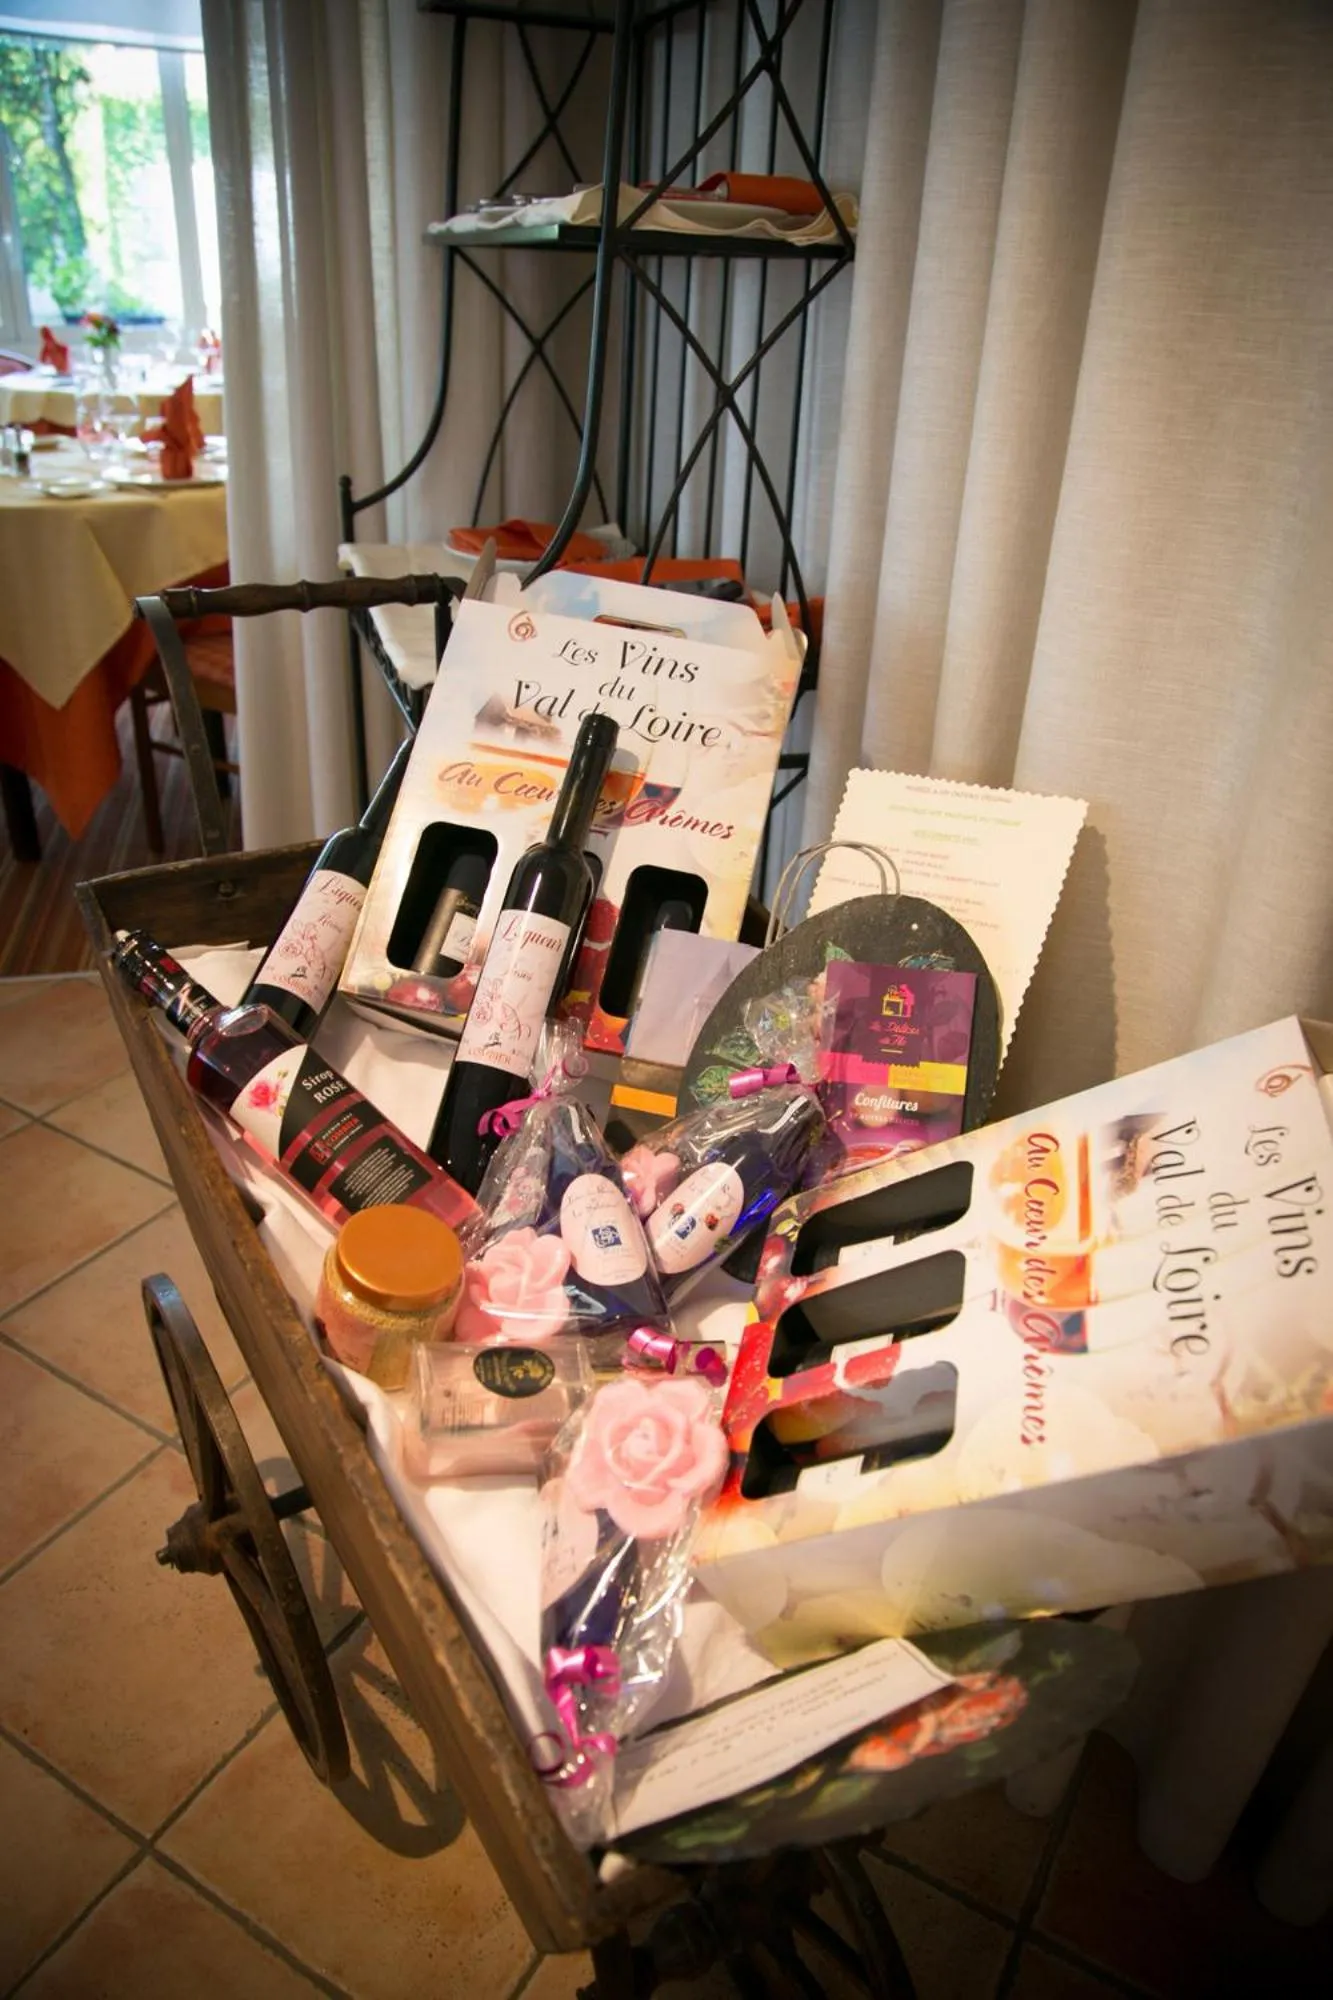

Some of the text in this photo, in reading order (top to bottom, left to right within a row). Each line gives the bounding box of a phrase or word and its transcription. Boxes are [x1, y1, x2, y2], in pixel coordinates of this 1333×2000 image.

[556, 638, 700, 683] Les Vins
[598, 676, 637, 702] du
[513, 680, 575, 720] Val
[620, 702, 723, 748] Loire
[438, 762, 484, 788] Au
[623, 798, 736, 841] Arômes
[301, 1069, 335, 1092] Sirop
[313, 1080, 349, 1104] ROSE
[853, 1091, 920, 1114] Confitures
[1025, 1131, 1061, 1174] Au
[1207, 1190, 1251, 1233] du
[1243, 1123, 1325, 1280] Les Vins
[1150, 1116, 1223, 1357] Val de Loire
[1022, 1255, 1058, 1300] des
[1019, 1311, 1063, 1447] Arômes
